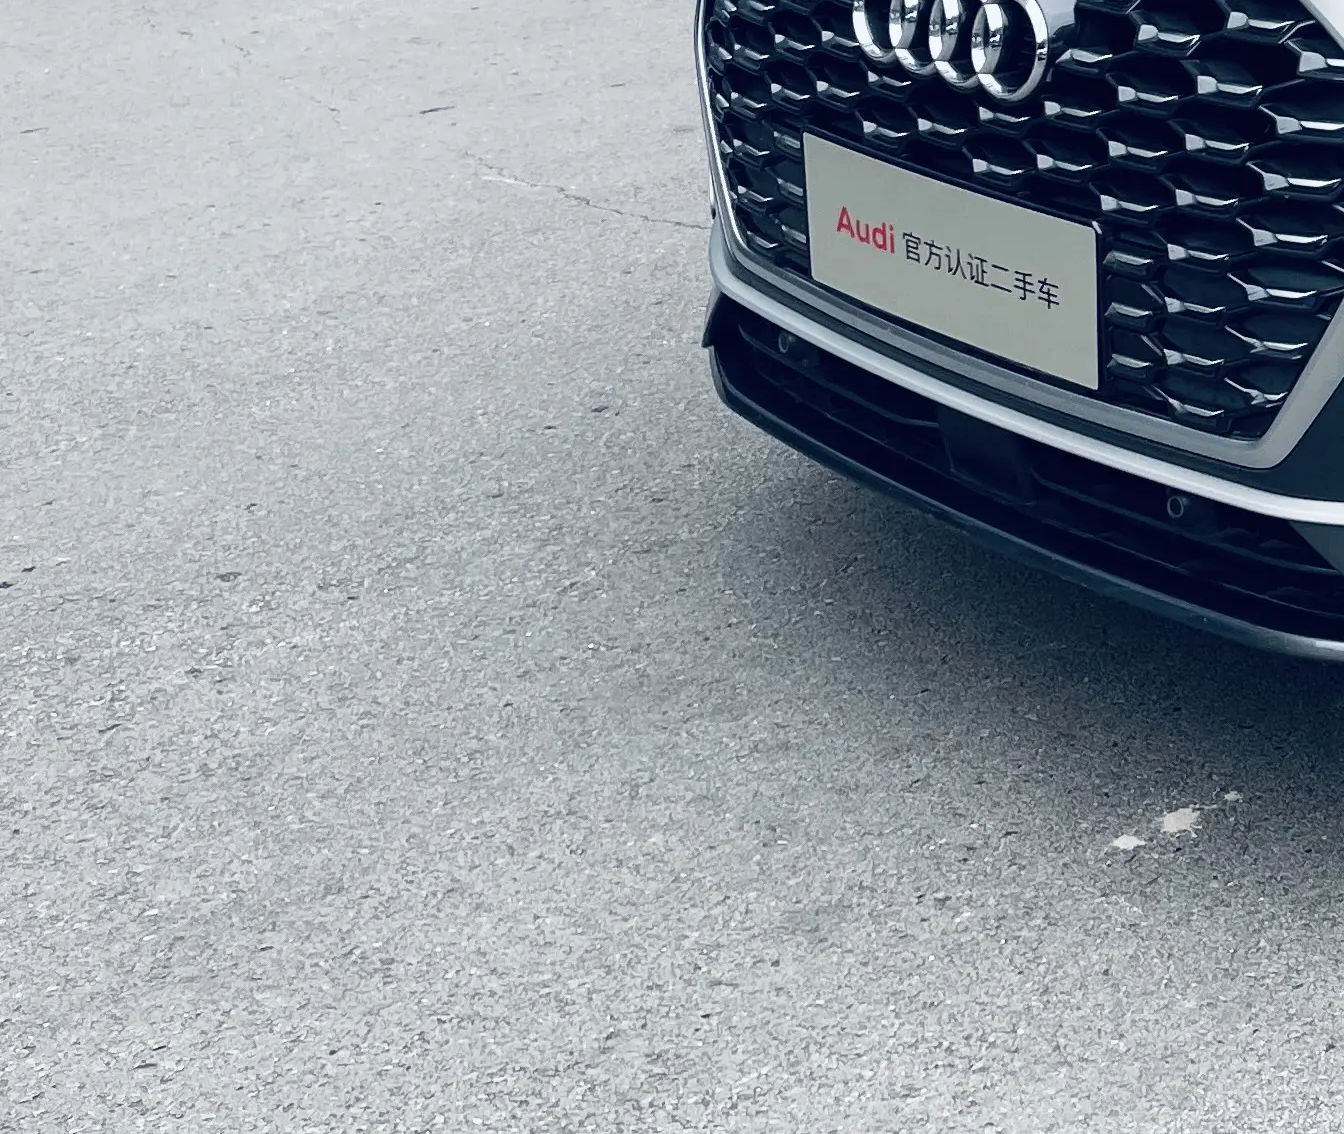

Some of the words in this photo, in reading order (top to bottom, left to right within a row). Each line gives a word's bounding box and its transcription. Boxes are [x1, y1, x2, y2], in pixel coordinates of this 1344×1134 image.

[836, 205, 895, 254] Audi
[902, 231, 1060, 310] 官方认证二手车
